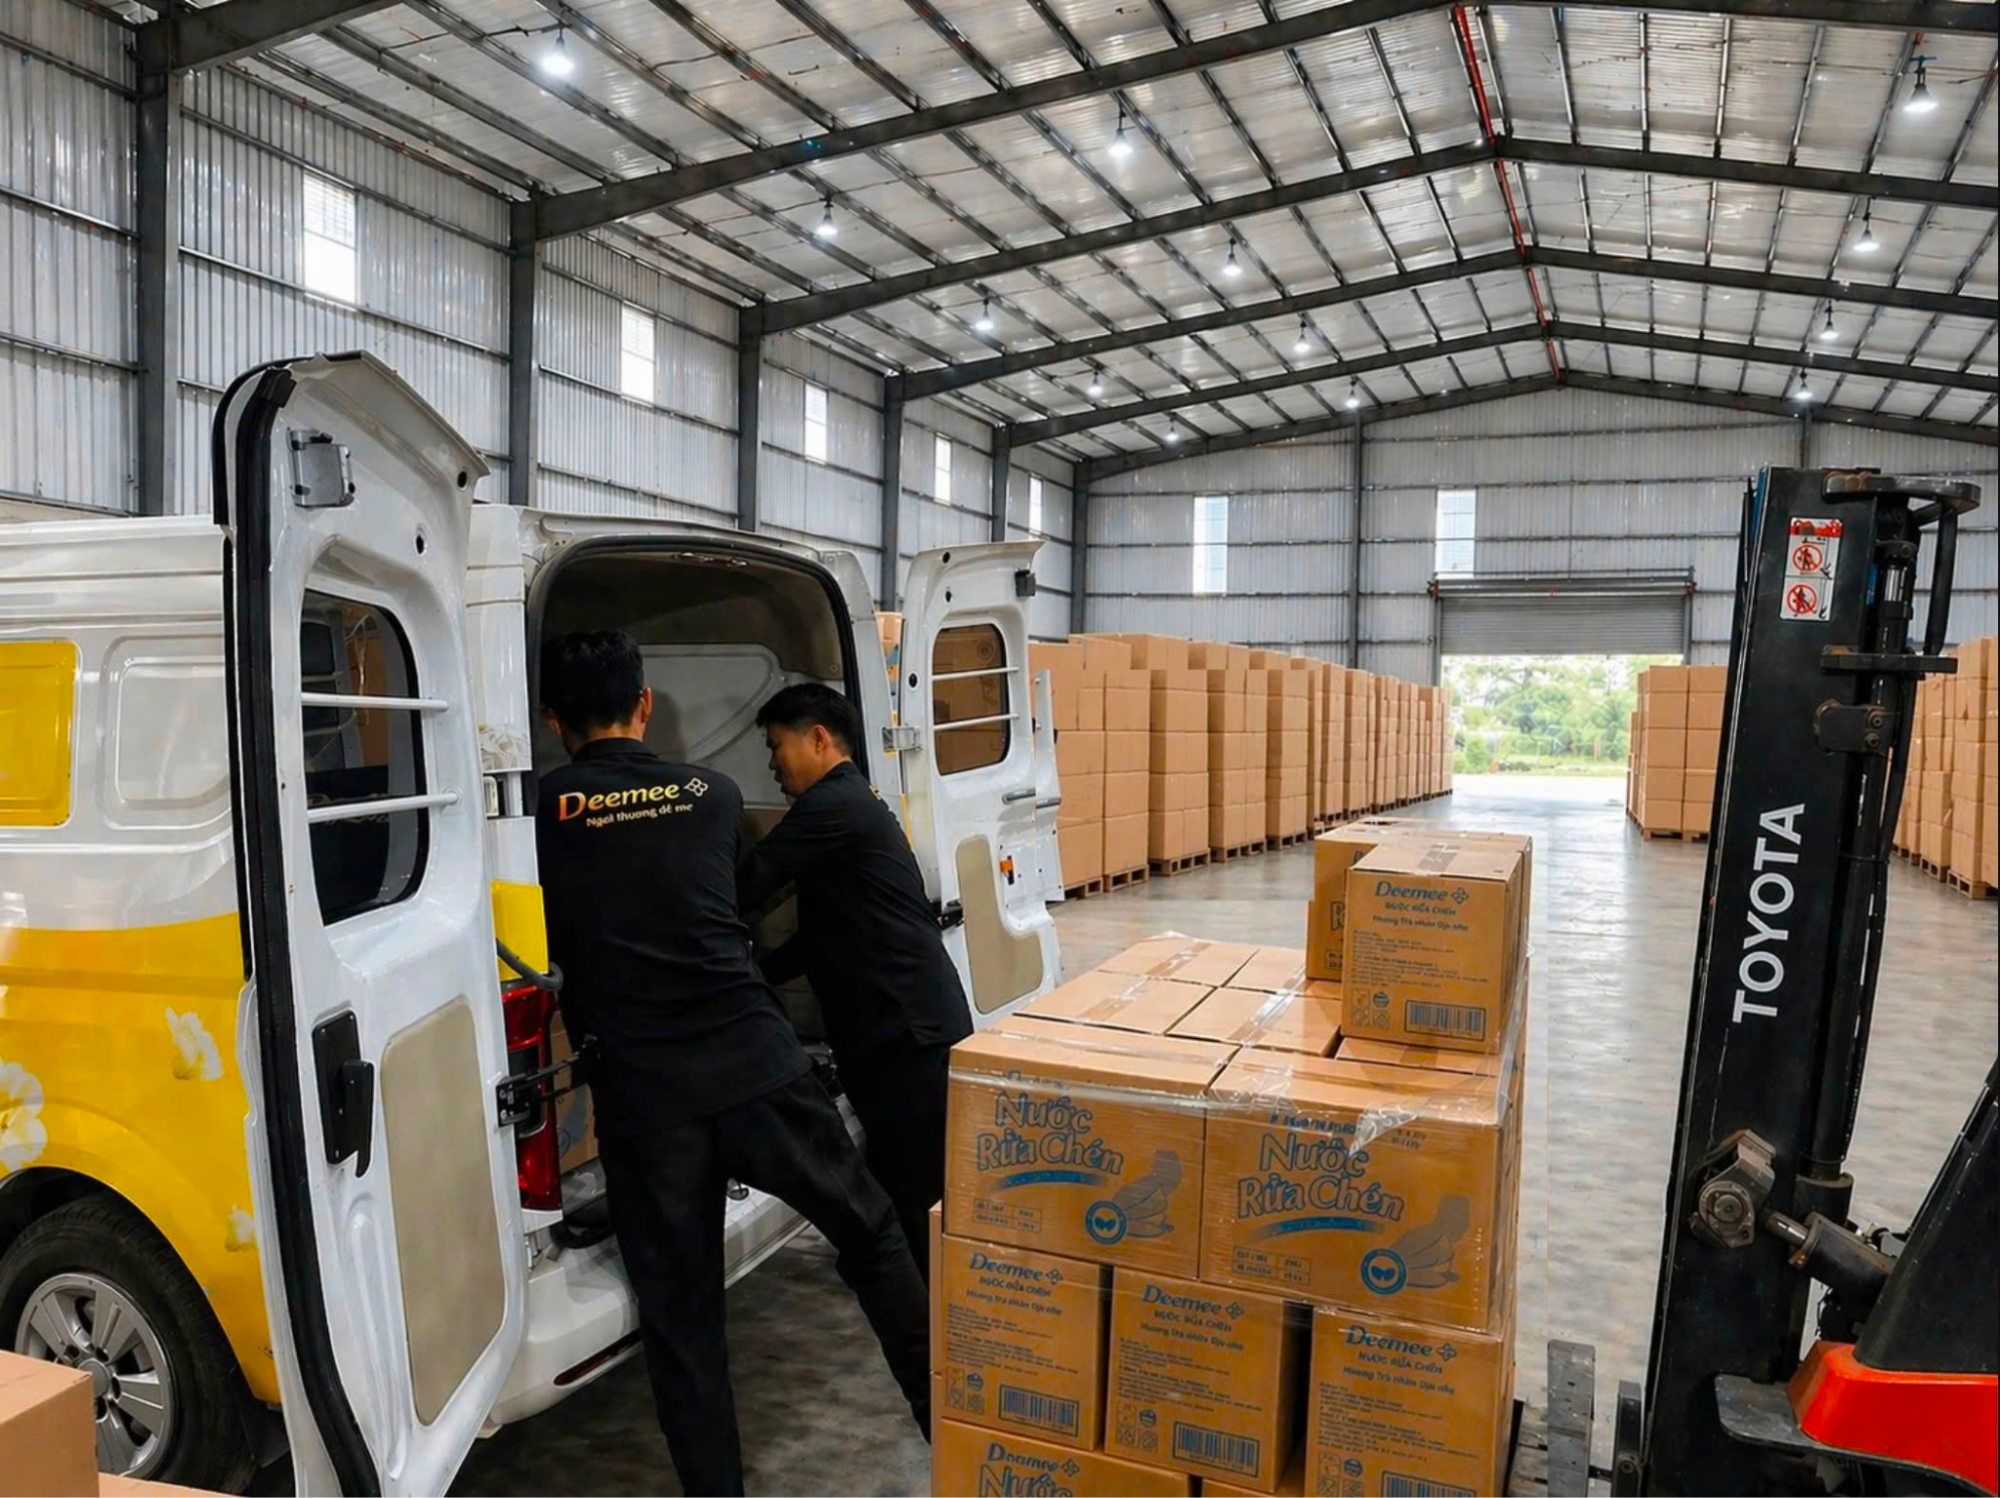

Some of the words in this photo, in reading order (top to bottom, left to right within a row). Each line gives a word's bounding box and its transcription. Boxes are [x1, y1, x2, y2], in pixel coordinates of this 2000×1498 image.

[558, 784, 681, 821] Deemee
[1375, 881, 1448, 901] Deemee
[1732, 803, 1805, 1024] TOYOTA
[1040, 1131, 1124, 1175] Chén
[1308, 1174, 1405, 1222] Chén
[969, 1252, 1044, 1281] Deemee
[1142, 1284, 1222, 1315] Deemee
[1346, 1325, 1433, 1356] Deemee
